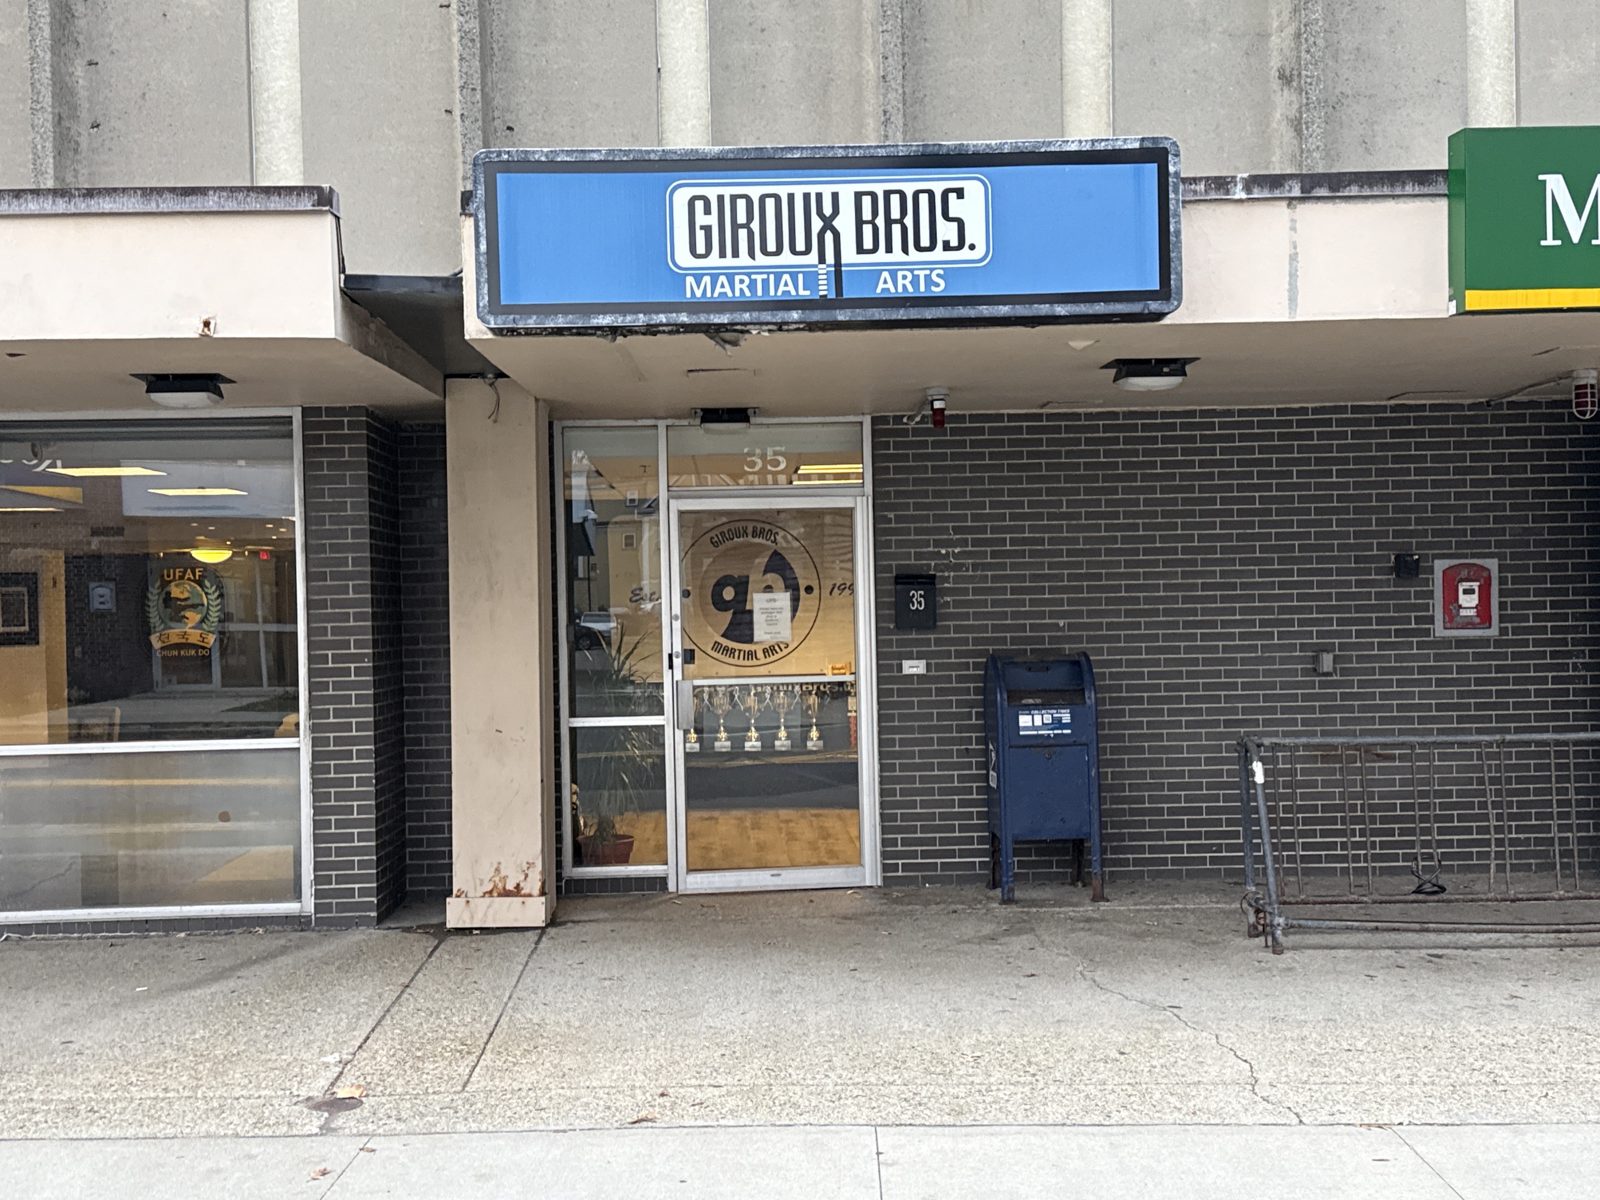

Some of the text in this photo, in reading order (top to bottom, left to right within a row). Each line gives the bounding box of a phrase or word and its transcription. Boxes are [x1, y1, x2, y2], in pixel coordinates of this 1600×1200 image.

[1537, 173, 1600, 246] M
[687, 187, 977, 264] GIROUX BROS.
[685, 269, 946, 299] MARTIAL ARTS
[743, 446, 787, 472] 35
[709, 525, 779, 548] GIROUX BROS.
[163, 567, 204, 581] UFAF
[909, 590, 925, 611] 35
[711, 640, 761, 661] MARTIAL
